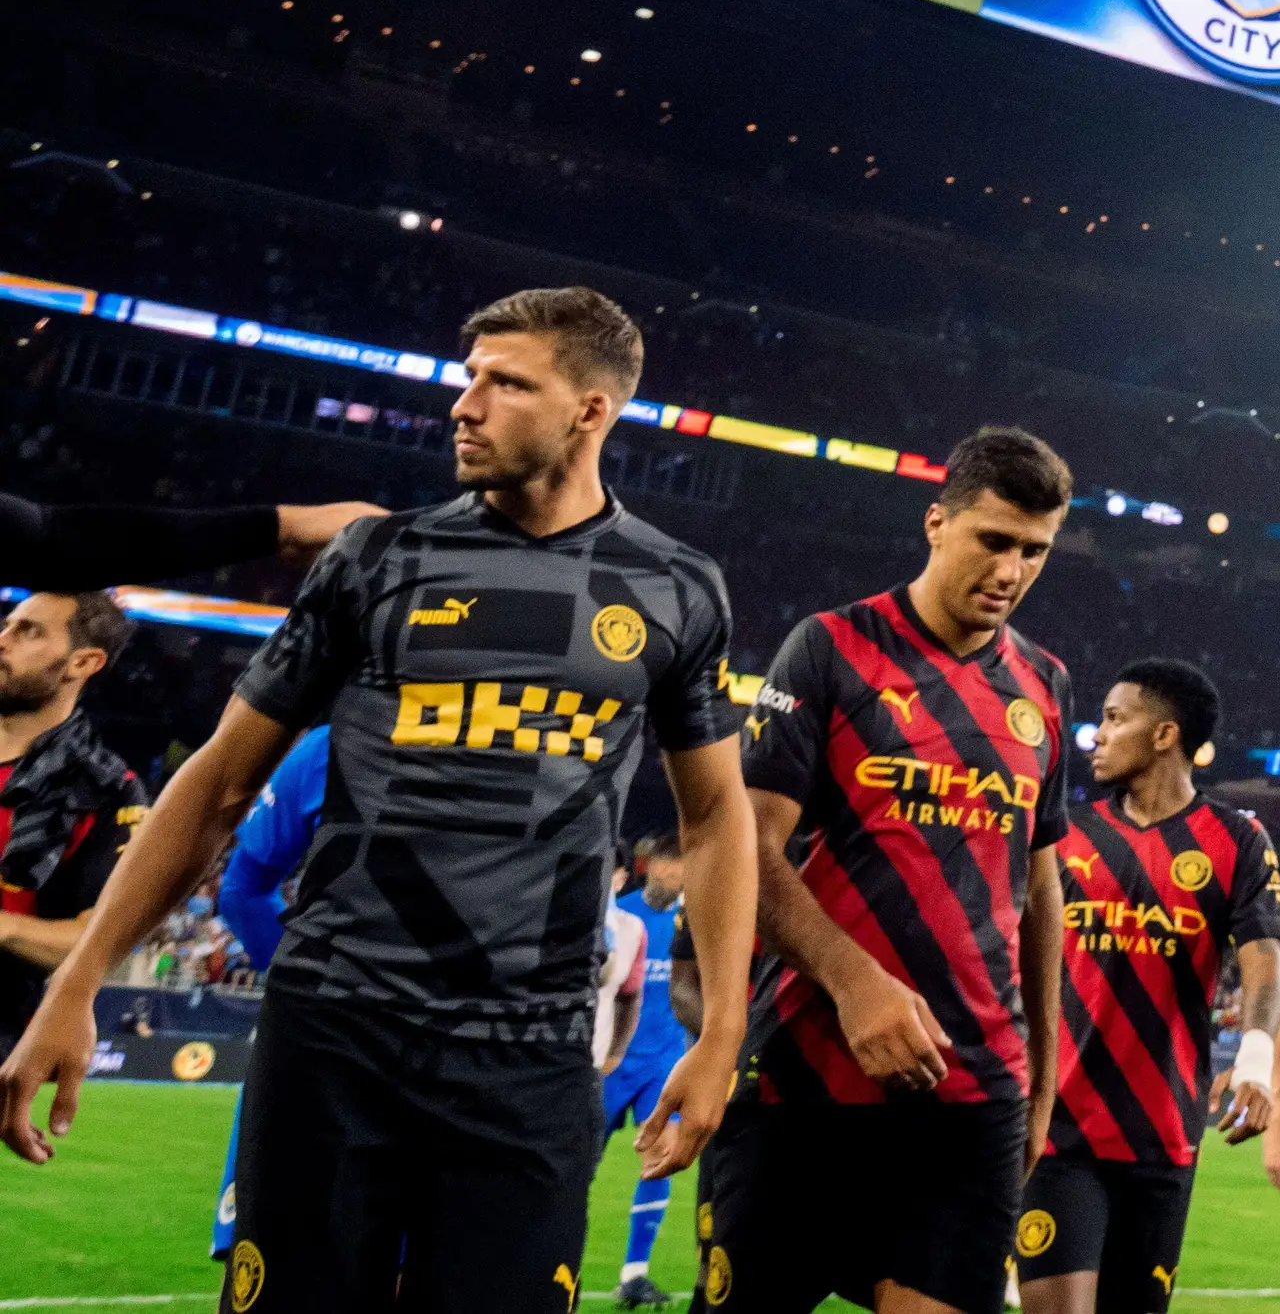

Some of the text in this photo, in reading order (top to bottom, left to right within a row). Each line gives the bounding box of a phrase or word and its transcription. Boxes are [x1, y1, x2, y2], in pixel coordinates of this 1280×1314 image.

[408, 608, 461, 626] PUMA
[390, 682, 623, 763] OKX
[855, 755, 1041, 810] ETIHAD
[885, 799, 1015, 834] AIRWAYS
[1063, 900, 1207, 935] ETIHAD
[1076, 933, 1178, 957] AIRWAYS
